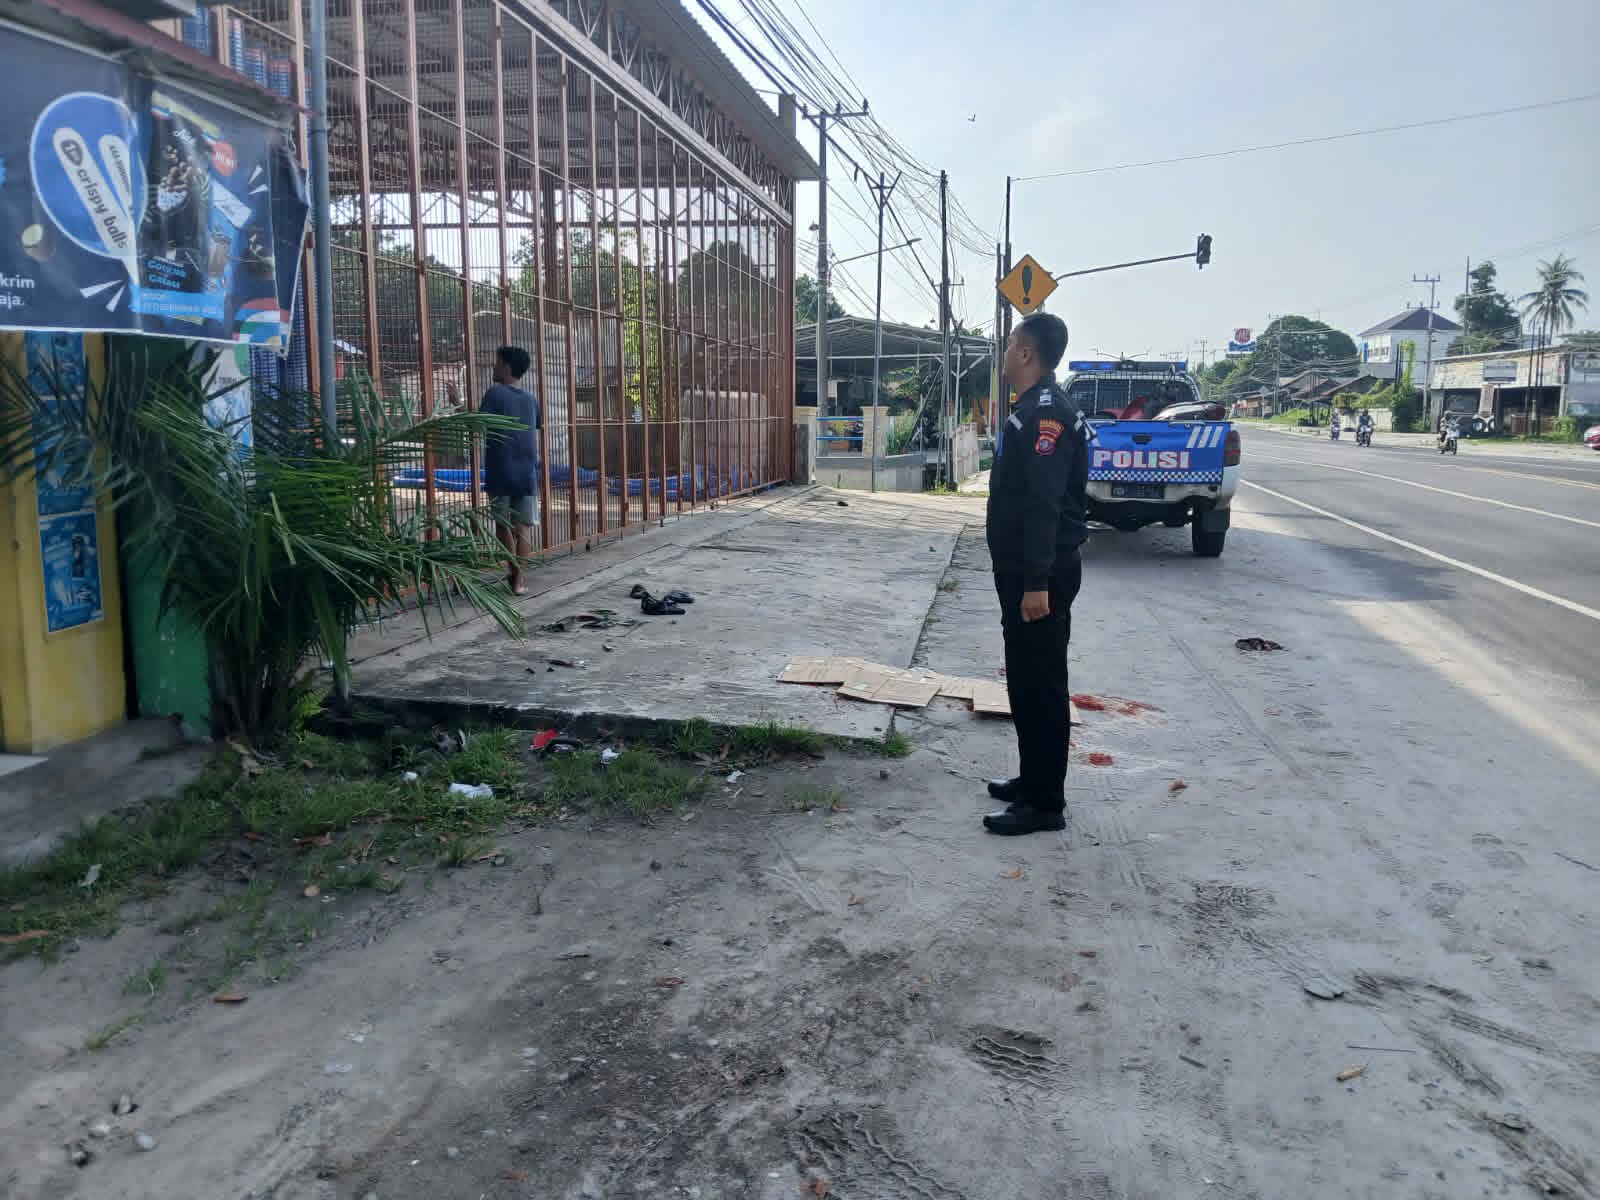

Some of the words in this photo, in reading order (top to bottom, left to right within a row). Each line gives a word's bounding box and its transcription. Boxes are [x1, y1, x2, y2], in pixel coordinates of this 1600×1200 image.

[77, 168, 109, 214] crispy
[103, 215, 128, 249] balls
[1092, 449, 1190, 469] POLISI
